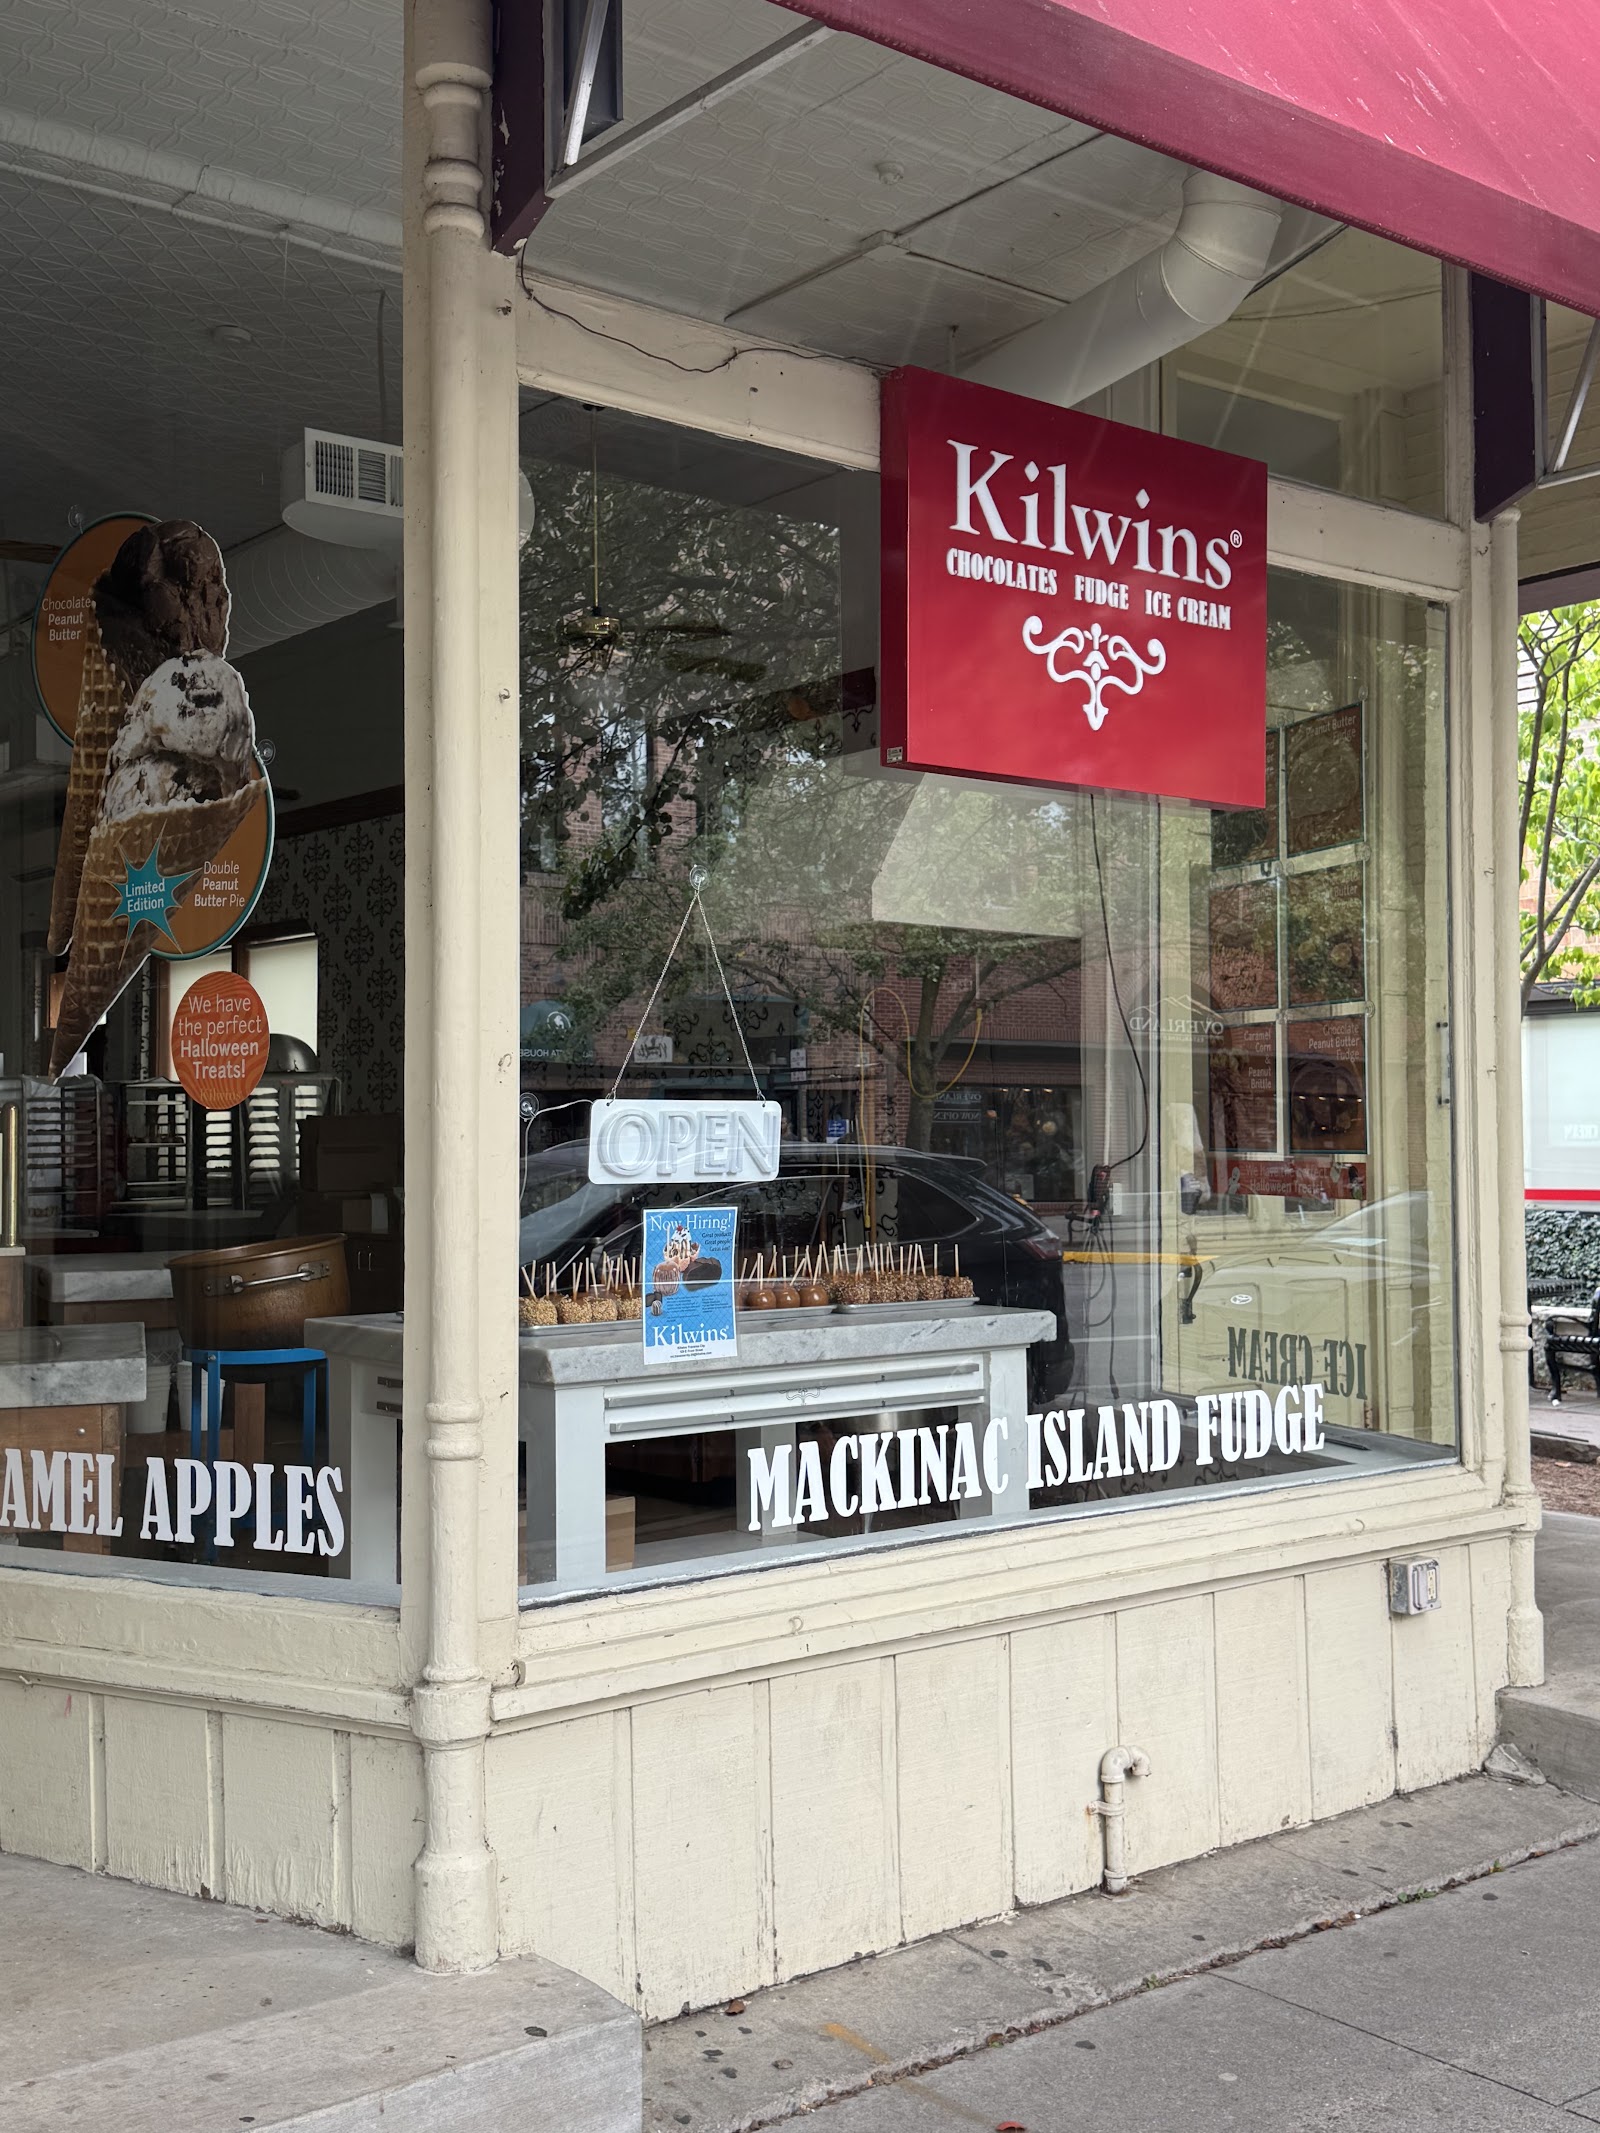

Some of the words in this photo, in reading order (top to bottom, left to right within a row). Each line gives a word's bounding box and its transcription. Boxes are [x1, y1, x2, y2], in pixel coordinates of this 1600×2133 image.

[946, 438, 1232, 590] Kilwins
[945, 547, 1058, 597] CHOCOLATES
[1073, 574, 1130, 611] FUDGE
[1144, 588, 1172, 620] ICE
[1177, 597, 1232, 631] CREAM
[41, 595, 93, 612] Chocolate
[47, 611, 85, 627] Peanut
[48, 627, 83, 642] Butter
[1332, 714, 1357, 730] Butter
[203, 860, 241, 876] Double
[125, 879, 166, 898] Limited
[202, 877, 240, 892] Peanut
[127, 898, 165, 913] Edition
[193, 893, 228, 908] Butter
[229, 893, 246, 908] Pie
[188, 995, 212, 1014] We
[216, 993, 251, 1012] have
[178, 1018, 203, 1037] the
[206, 1015, 263, 1041] perfect
[1243, 1030, 1272, 1042] Caramel
[1322, 1022, 1360, 1036] Chocolate
[180, 1038, 260, 1059] Halloween
[1254, 1042, 1272, 1053] Corn
[1308, 1038, 1335, 1050] Peanut
[1335, 1036, 1360, 1048] Butter
[1336, 1048, 1360, 1063] Fudge
[193, 1059, 247, 1080] Treats!
[1248, 1067, 1272, 1078] Peanut
[1250, 1078, 1272, 1090] Brittle
[597, 1108, 778, 1177] OPEN
[1249, 1178, 1292, 1192] Halloween
[650, 1215, 682, 1232] Now
[686, 1212, 732, 1232] Hiring!
[652, 1323, 729, 1347] Kilwins
[747, 1416, 1009, 1532] MACKINAC
[1024, 1398, 1182, 1491] ISLAND
[1195, 1383, 1326, 1466] FUDGE
[0, 1448, 124, 1538] AMEL
[139, 1456, 346, 1558] APPLES
